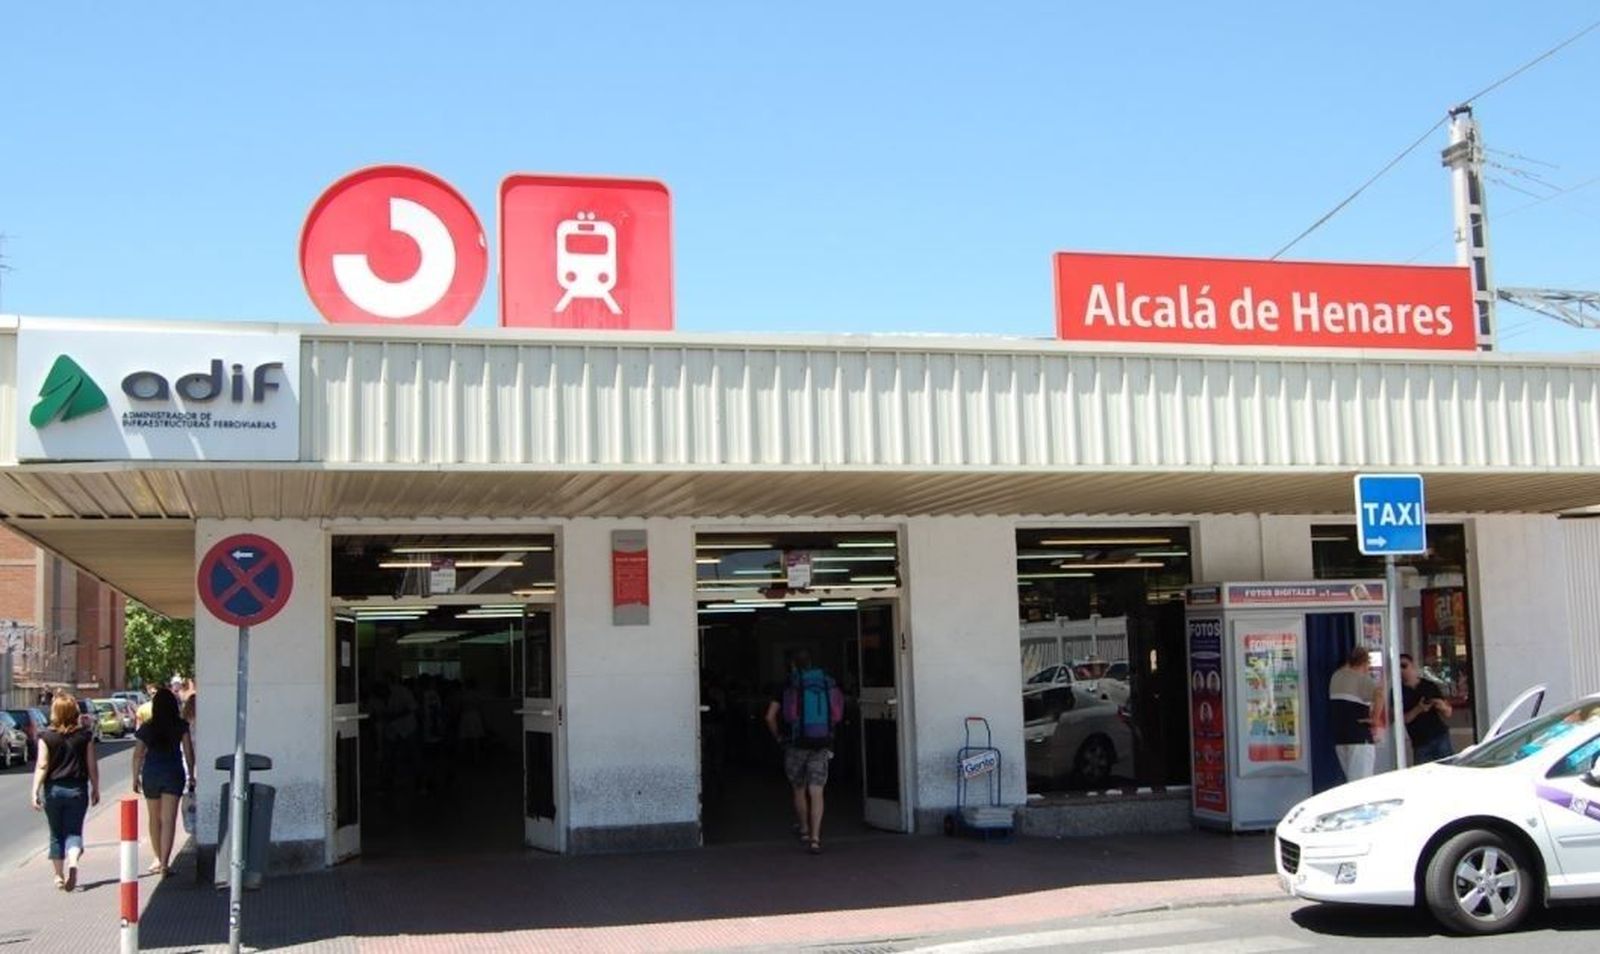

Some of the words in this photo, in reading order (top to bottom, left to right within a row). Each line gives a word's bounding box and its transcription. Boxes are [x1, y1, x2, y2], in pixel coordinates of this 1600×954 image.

[1083, 281, 1217, 330] Alcalá
[1229, 286, 1279, 331] de
[1292, 291, 1453, 336] Henares
[121, 358, 284, 404] adif
[122, 411, 197, 421] ADMINISTRADOR
[200, 412, 212, 421] DE
[122, 419, 211, 428] INFRAESTRUCTURAS
[213, 420, 277, 430] FERROVIARIAS
[1363, 502, 1421, 526] TAXI
[1244, 589, 1273, 598] FOTOS
[1274, 587, 1317, 597] DIGITALES
[1187, 622, 1221, 637] FOTOS
